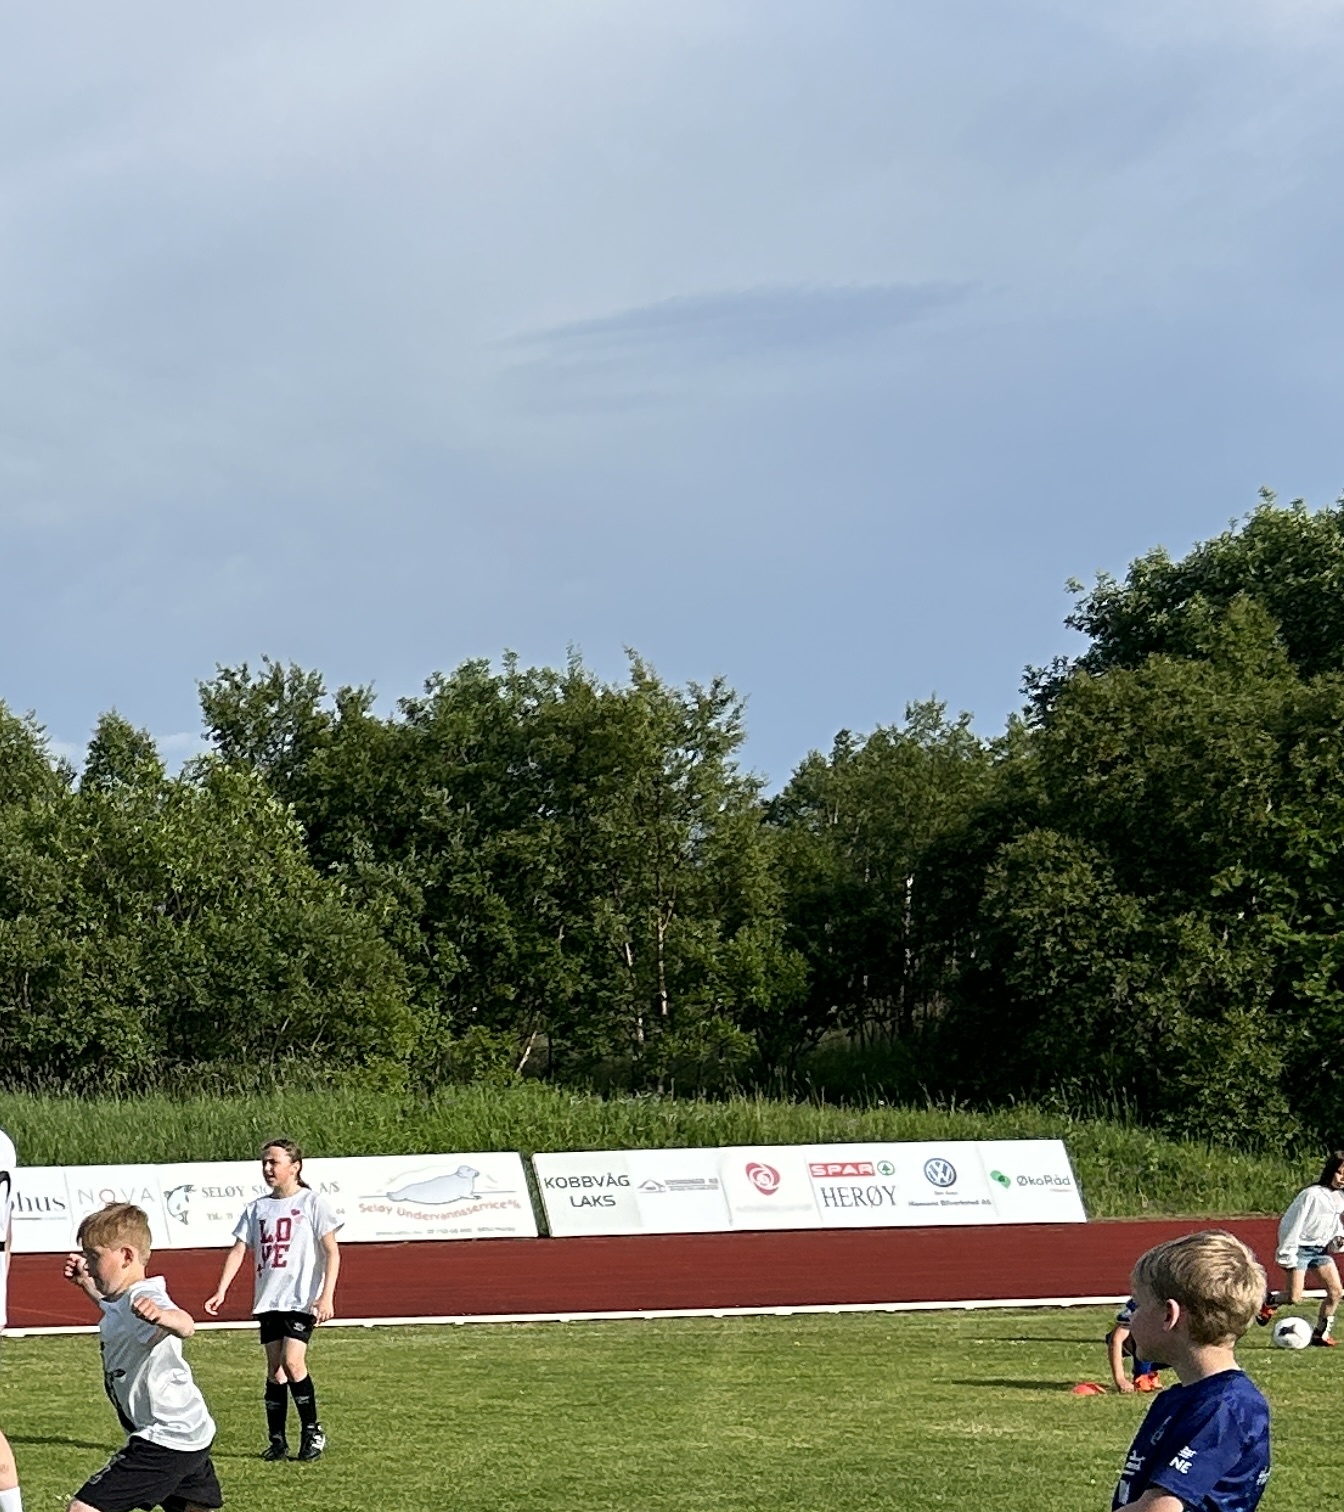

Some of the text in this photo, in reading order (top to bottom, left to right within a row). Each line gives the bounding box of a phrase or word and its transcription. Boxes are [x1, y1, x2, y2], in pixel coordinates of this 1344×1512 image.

[811, 1163, 874, 1177] SPAR
[543, 1172, 630, 1190] KOBBVÅG
[77, 1187, 156, 1206] NOVA
[569, 1194, 617, 1208] LAKS
[821, 1185, 897, 1209] HERØY
[259, 1216, 292, 1244] LO
